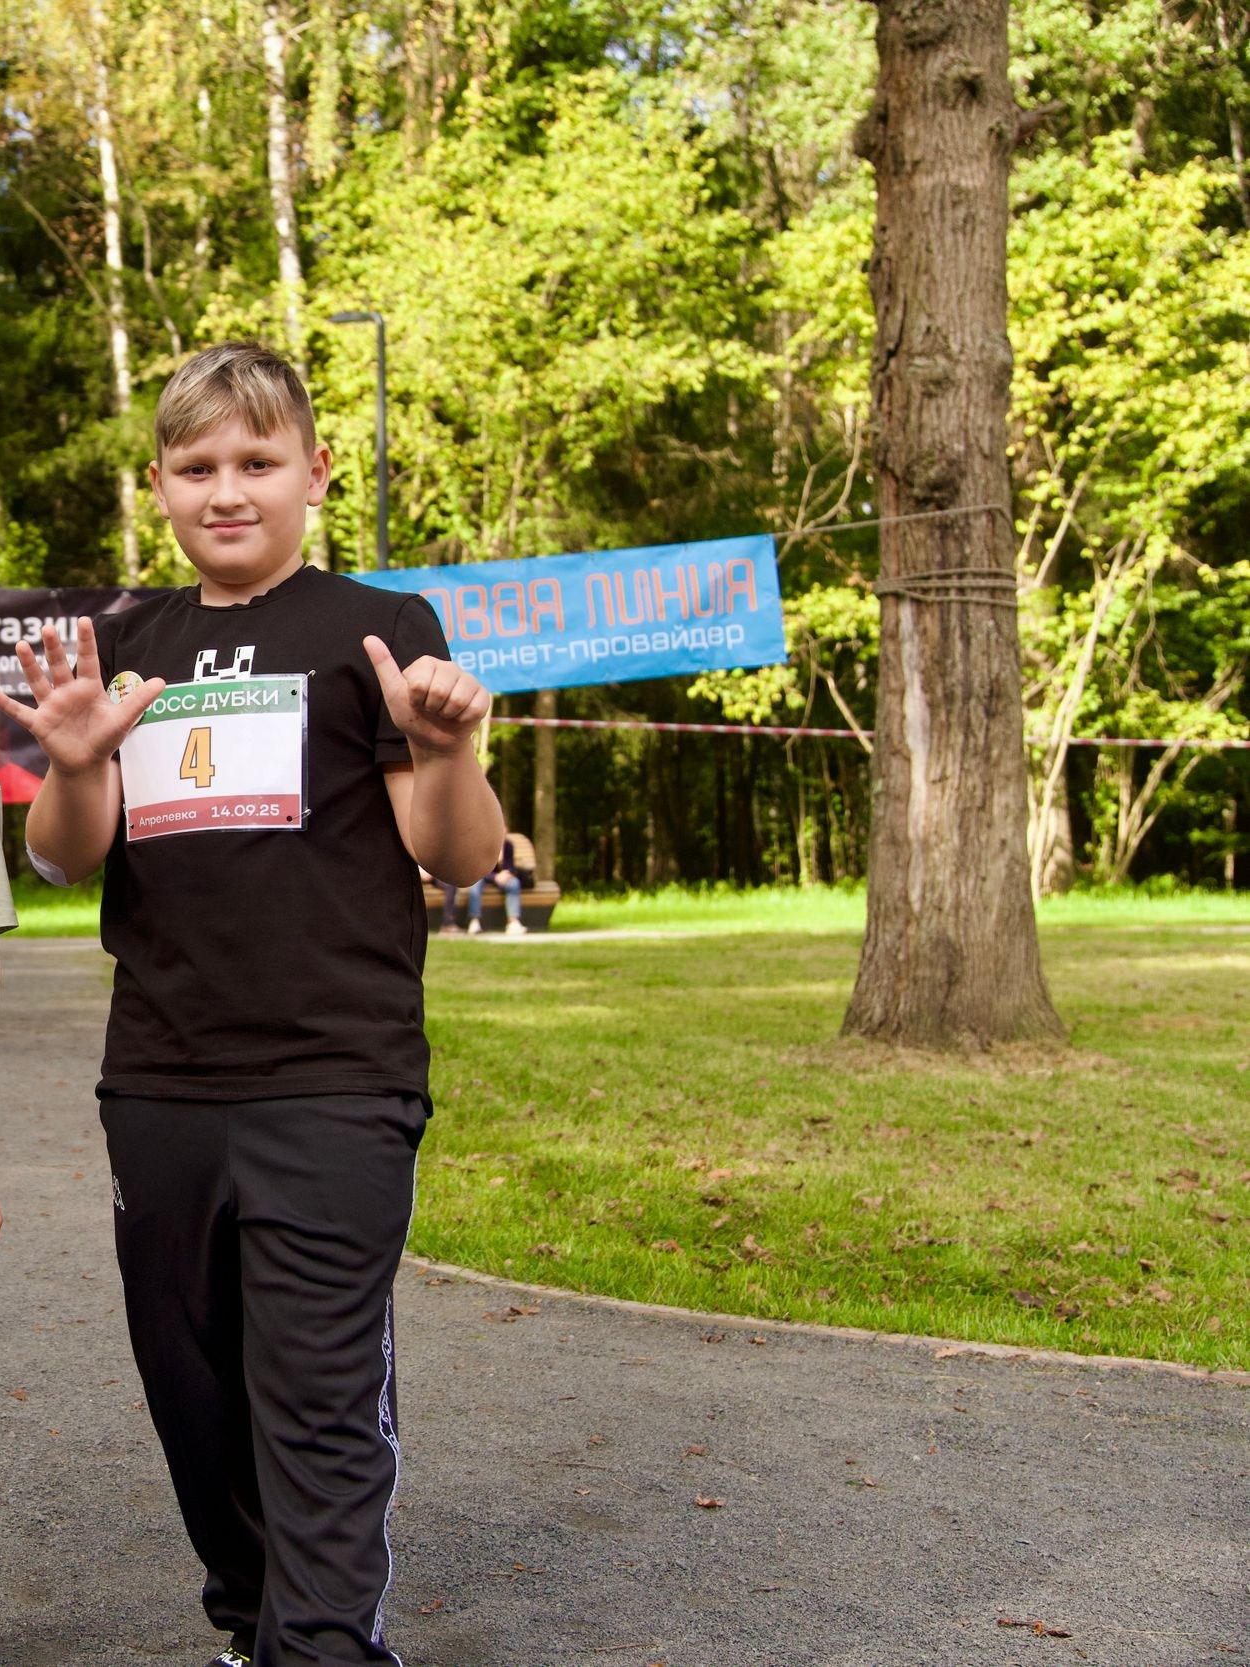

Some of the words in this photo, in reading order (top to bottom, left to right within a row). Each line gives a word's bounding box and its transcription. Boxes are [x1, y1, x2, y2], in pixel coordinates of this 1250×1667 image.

[420, 578, 565, 643] ОВАЯ
[585, 557, 758, 629] ЛИНИЯ
[451, 622, 746, 675] ернет-провайдер
[145, 695, 197, 715] ОСС
[201, 689, 279, 712] ДУБКИ
[180, 727, 215, 788] 4
[138, 809, 197, 827] Апрелевка
[211, 804, 280, 818] 14.09.25
